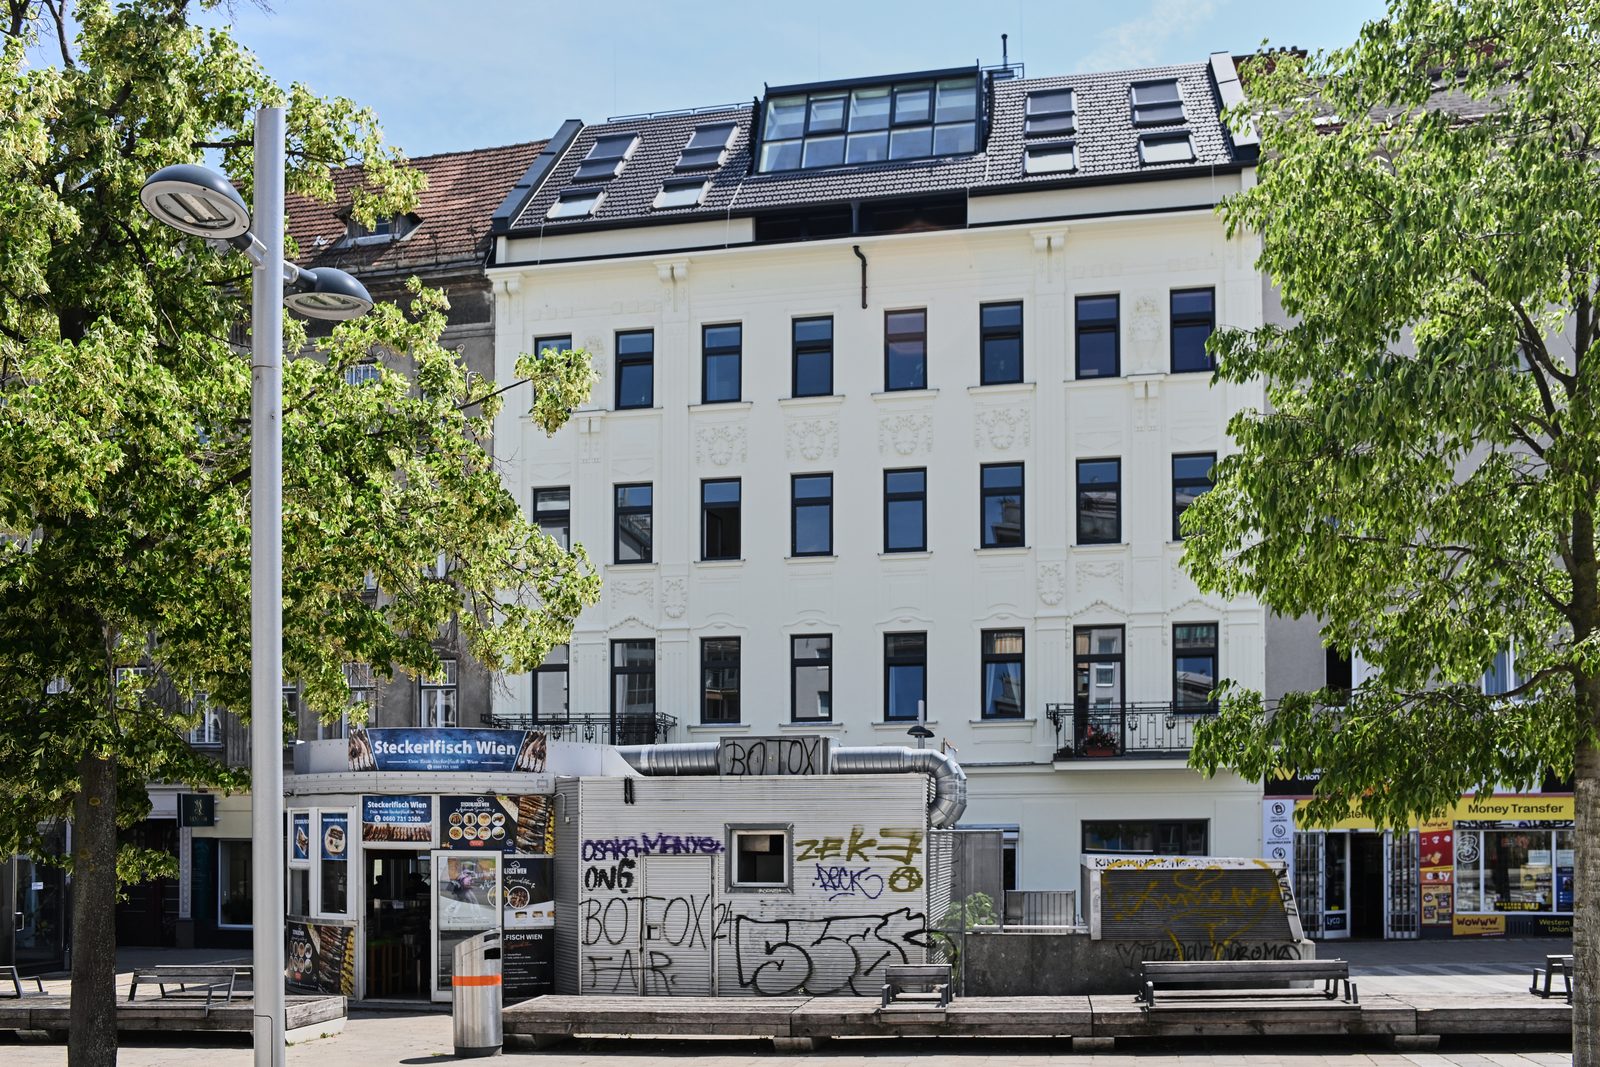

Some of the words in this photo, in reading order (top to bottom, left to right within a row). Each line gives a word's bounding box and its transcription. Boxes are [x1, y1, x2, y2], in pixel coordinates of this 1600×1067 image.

[374, 739, 473, 755] Steckerlfisch
[476, 740, 516, 756] Wien
[725, 739, 819, 775] BOTOX
[367, 801, 409, 809] Steckerlfisch
[410, 801, 427, 809] Wien
[1467, 803, 1509, 816] Money
[1510, 803, 1565, 814] Transfer
[526, 933, 543, 941] WIEN
